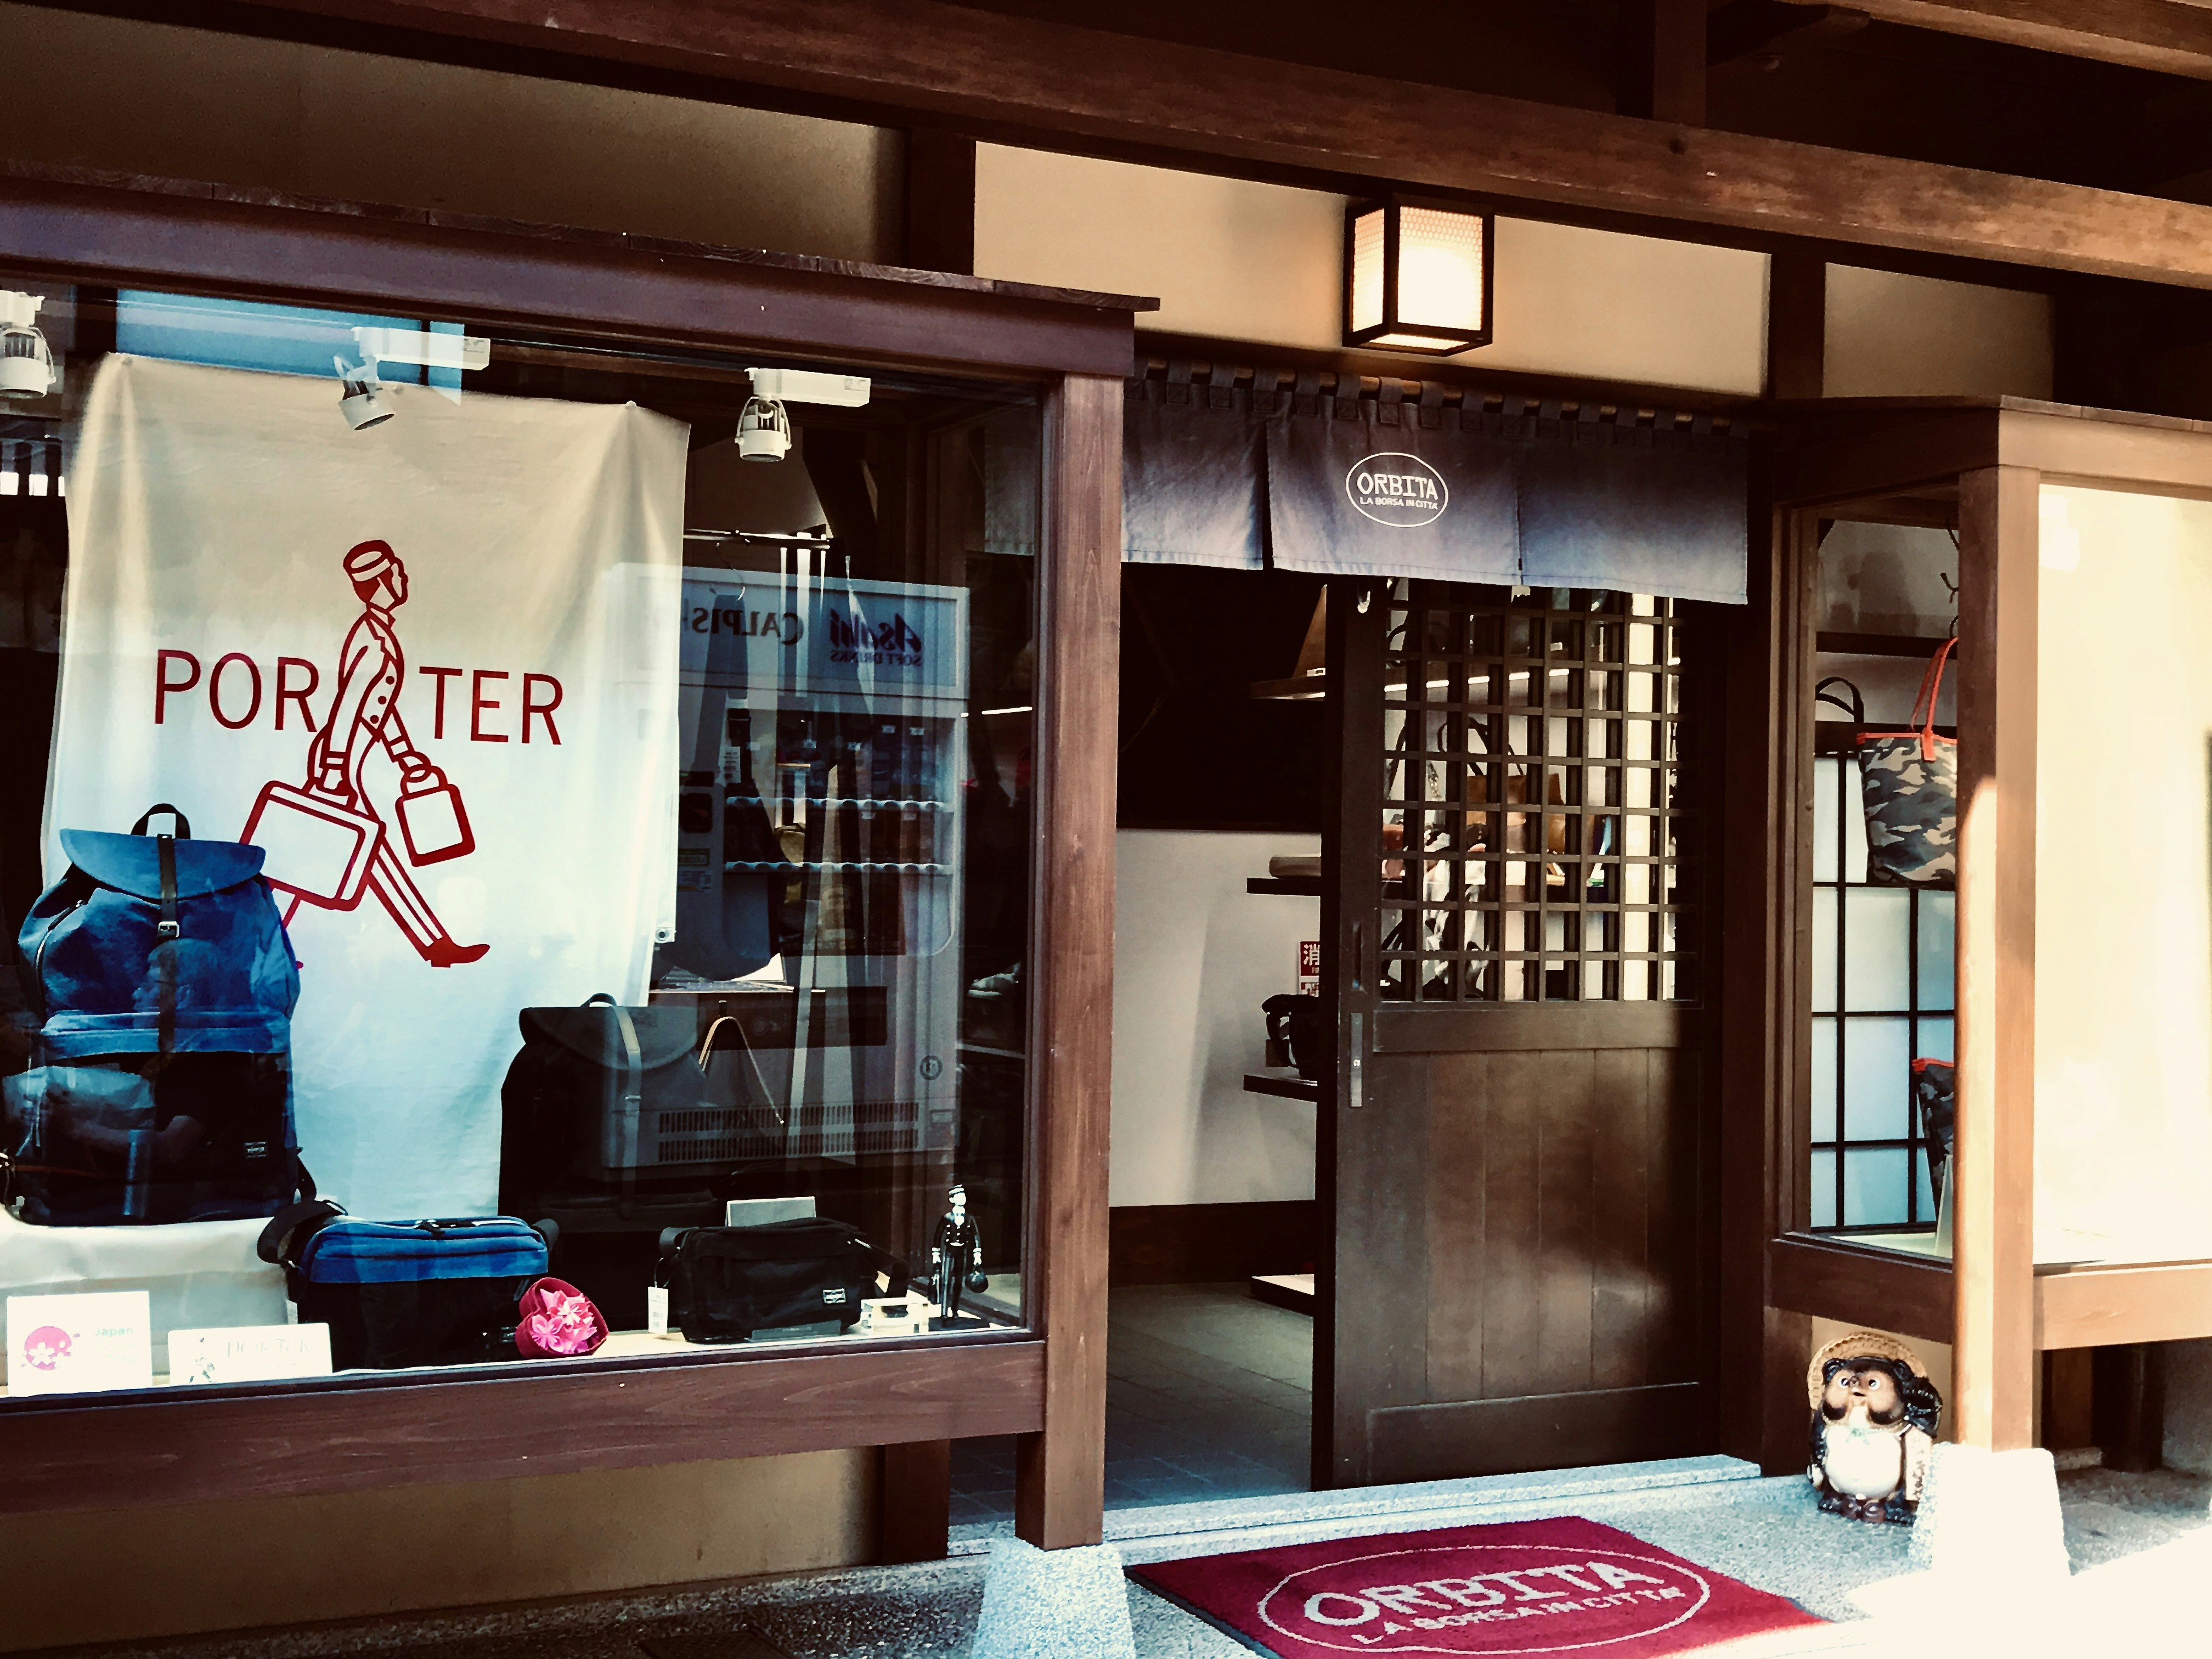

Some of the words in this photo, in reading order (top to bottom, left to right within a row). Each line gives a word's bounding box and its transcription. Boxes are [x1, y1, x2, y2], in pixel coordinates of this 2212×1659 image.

[1357, 472, 1438, 500] ORBITA
[1359, 496, 1374, 505] LA
[1375, 497, 1404, 506] BORSA
[94, 1325, 134, 1338] Japan
[1304, 1561, 1664, 1626] ORBITA
[1351, 1621, 1413, 1644] LA
[1410, 1606, 1547, 1630] BORSA
